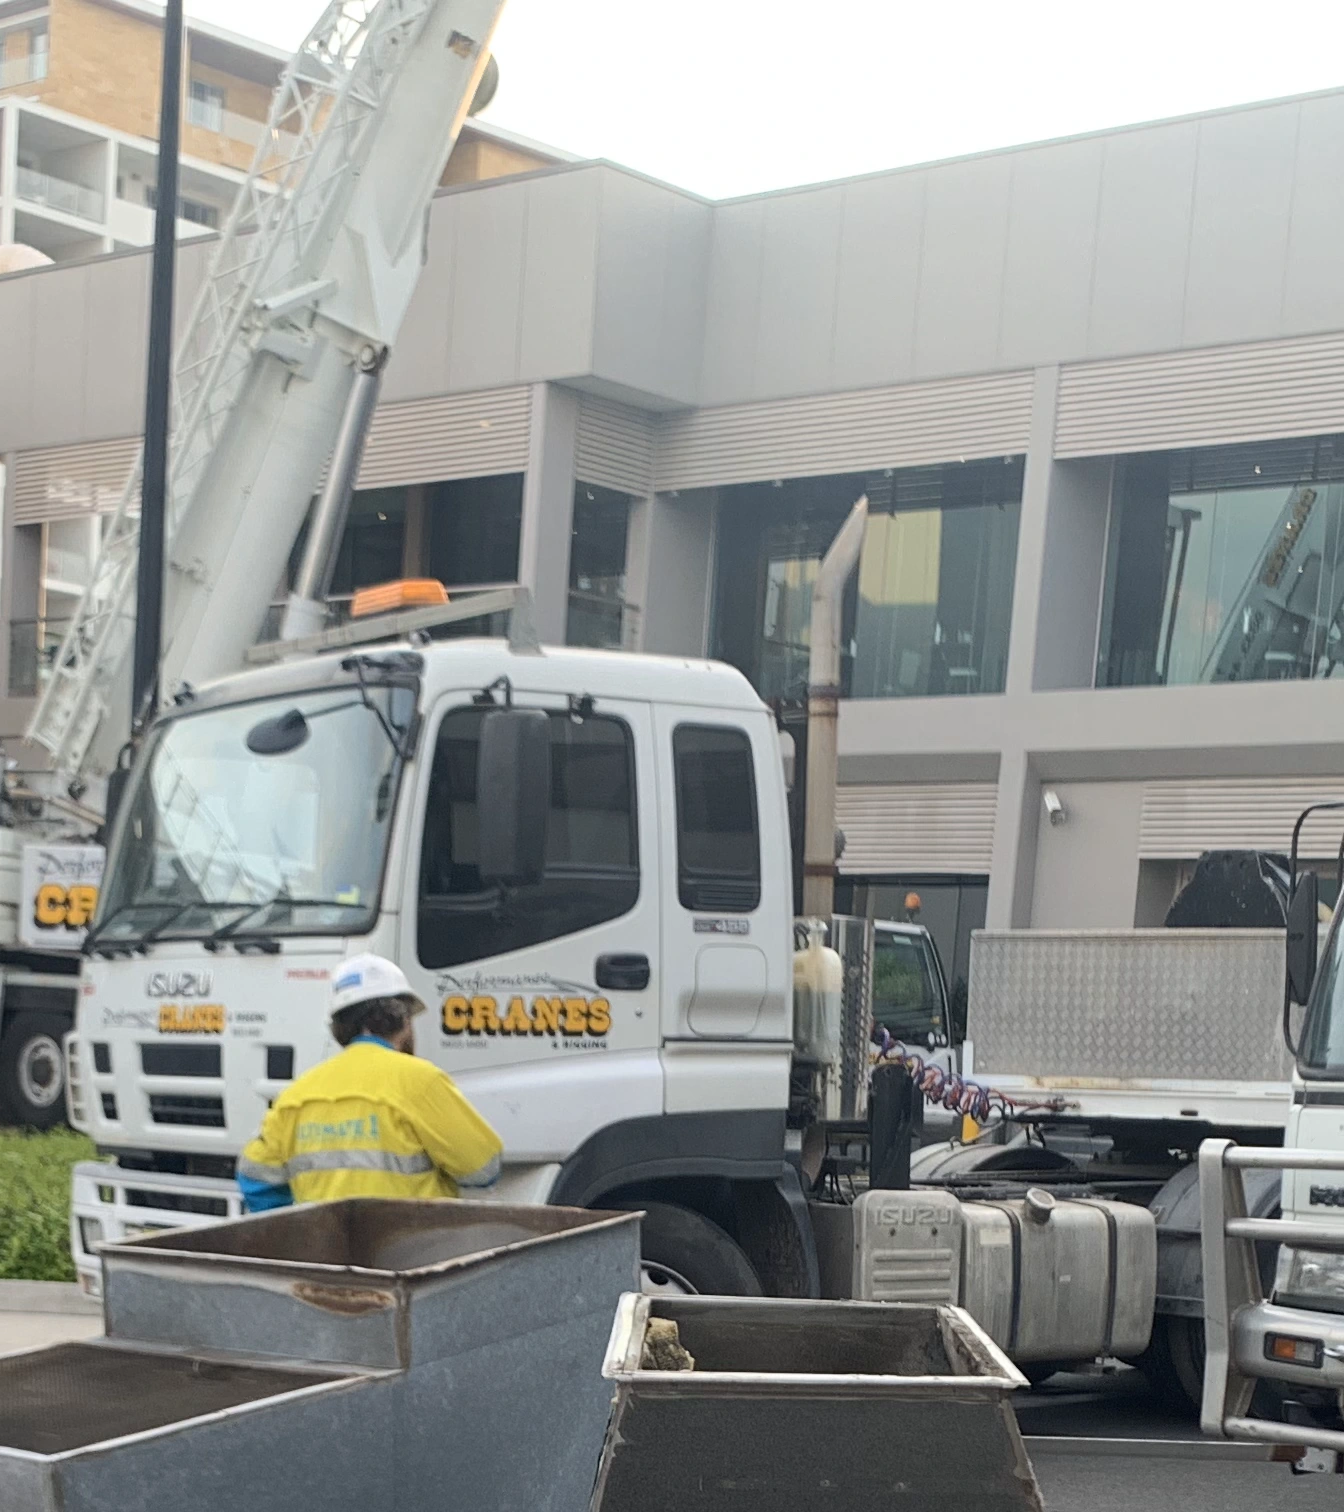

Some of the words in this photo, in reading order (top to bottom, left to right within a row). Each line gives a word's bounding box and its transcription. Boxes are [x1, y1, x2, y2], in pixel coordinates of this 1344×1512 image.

[147, 972, 213, 998] ISUZU
[442, 994, 612, 1037] CRANES
[562, 1040, 608, 1050] RIGGING
[874, 1206, 954, 1226] ISUZU
